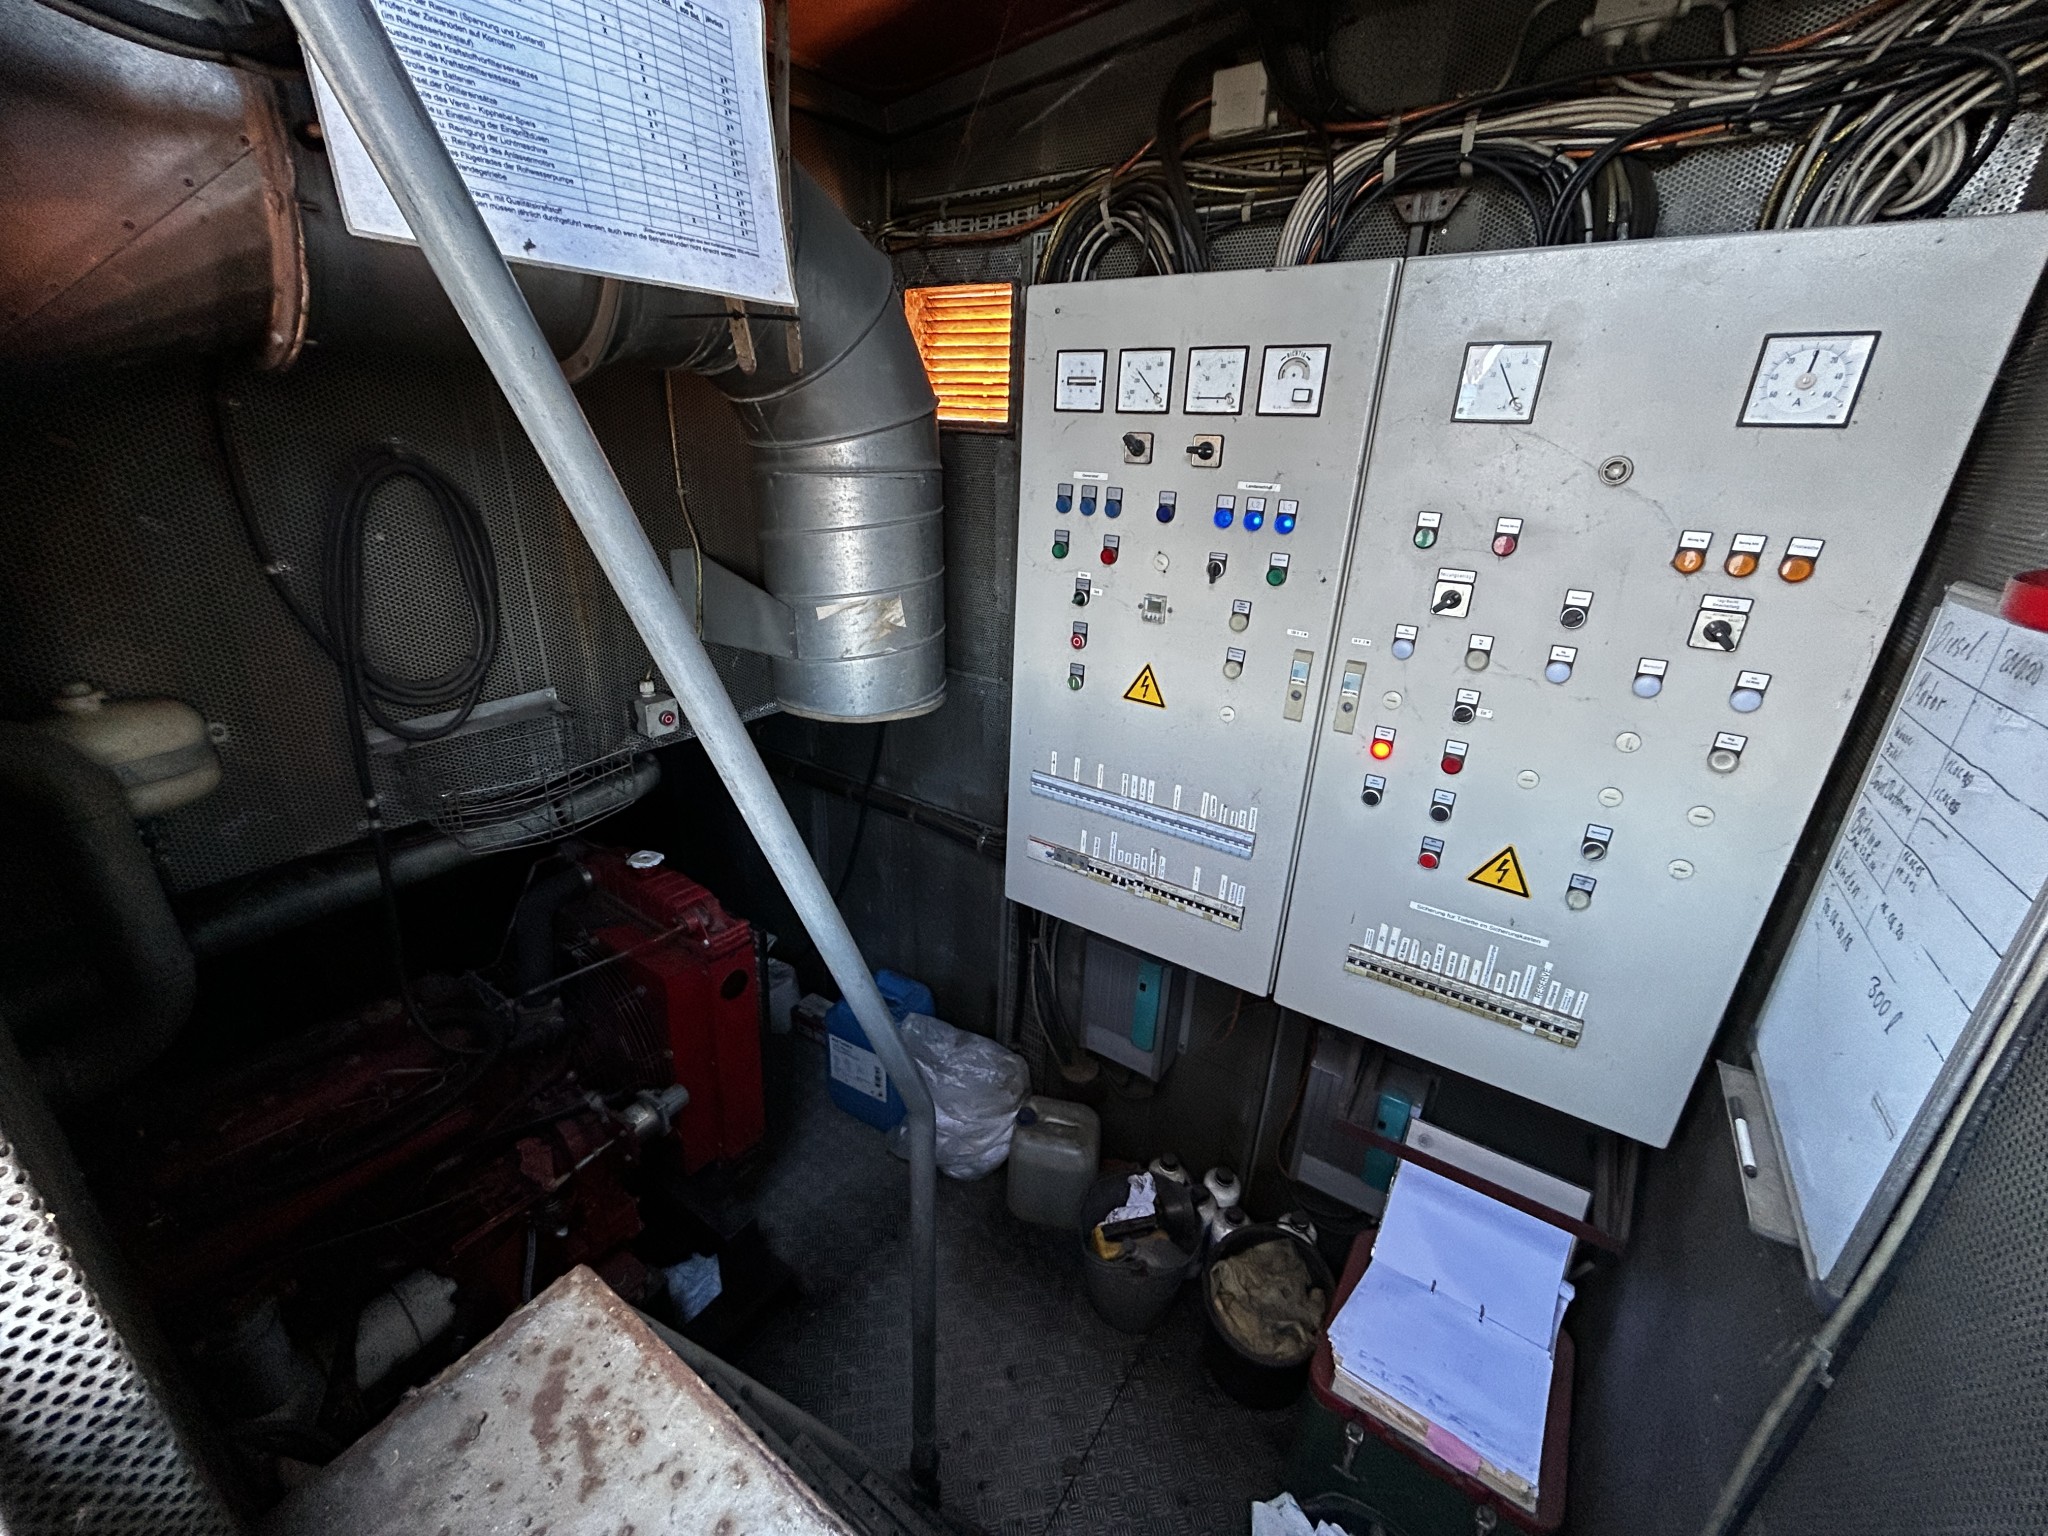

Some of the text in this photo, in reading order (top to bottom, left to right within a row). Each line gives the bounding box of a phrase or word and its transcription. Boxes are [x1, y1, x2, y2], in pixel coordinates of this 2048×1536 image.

[407, 8, 421, 19] der
[423, 12, 468, 34] Zinkanoden
[468, 28, 481, 39] auf
[482, 32, 517, 52] Korrosion
[428, 0, 459, 18] Riemen
[460, 12, 500, 34] (Spannung
[500, 27, 515, 38] und
[516, 31, 546, 49] Zustand)
[428, 40, 443, 51] des
[424, 51, 439, 62] des
[427, 66, 440, 77] der
[429, 80, 442, 90] der
[433, 94, 448, 104] des
[445, 109, 486, 129] Einstellung
[487, 121, 499, 131] der
[448, 123, 486, 141] Reinigung
[487, 133, 499, 143] der
[500, 137, 548, 156] Lichtmaschine
[451, 135, 489, 154] Reinigung
[489, 146, 503, 156] des
[503, 162, 515, 170] der
[517, 208, 542, 221] jährlich
[542, 212, 583, 229] durchgeführt
[607, 226, 623, 236] auch
[623, 230, 639, 240] wenn
[638, 233, 648, 242] die
[1770, 373, 1779, 381] 40
[1834, 372, 1844, 380] 40
[1768, 391, 1778, 399] 60
[1822, 391, 1832, 399] 60
[1791, 398, 1801, 407] A
[1416, 903, 1446, 917] Sicherung
[1534, 967, 1552, 999] RESERVE
[1867, 975, 1891, 1017] 300
